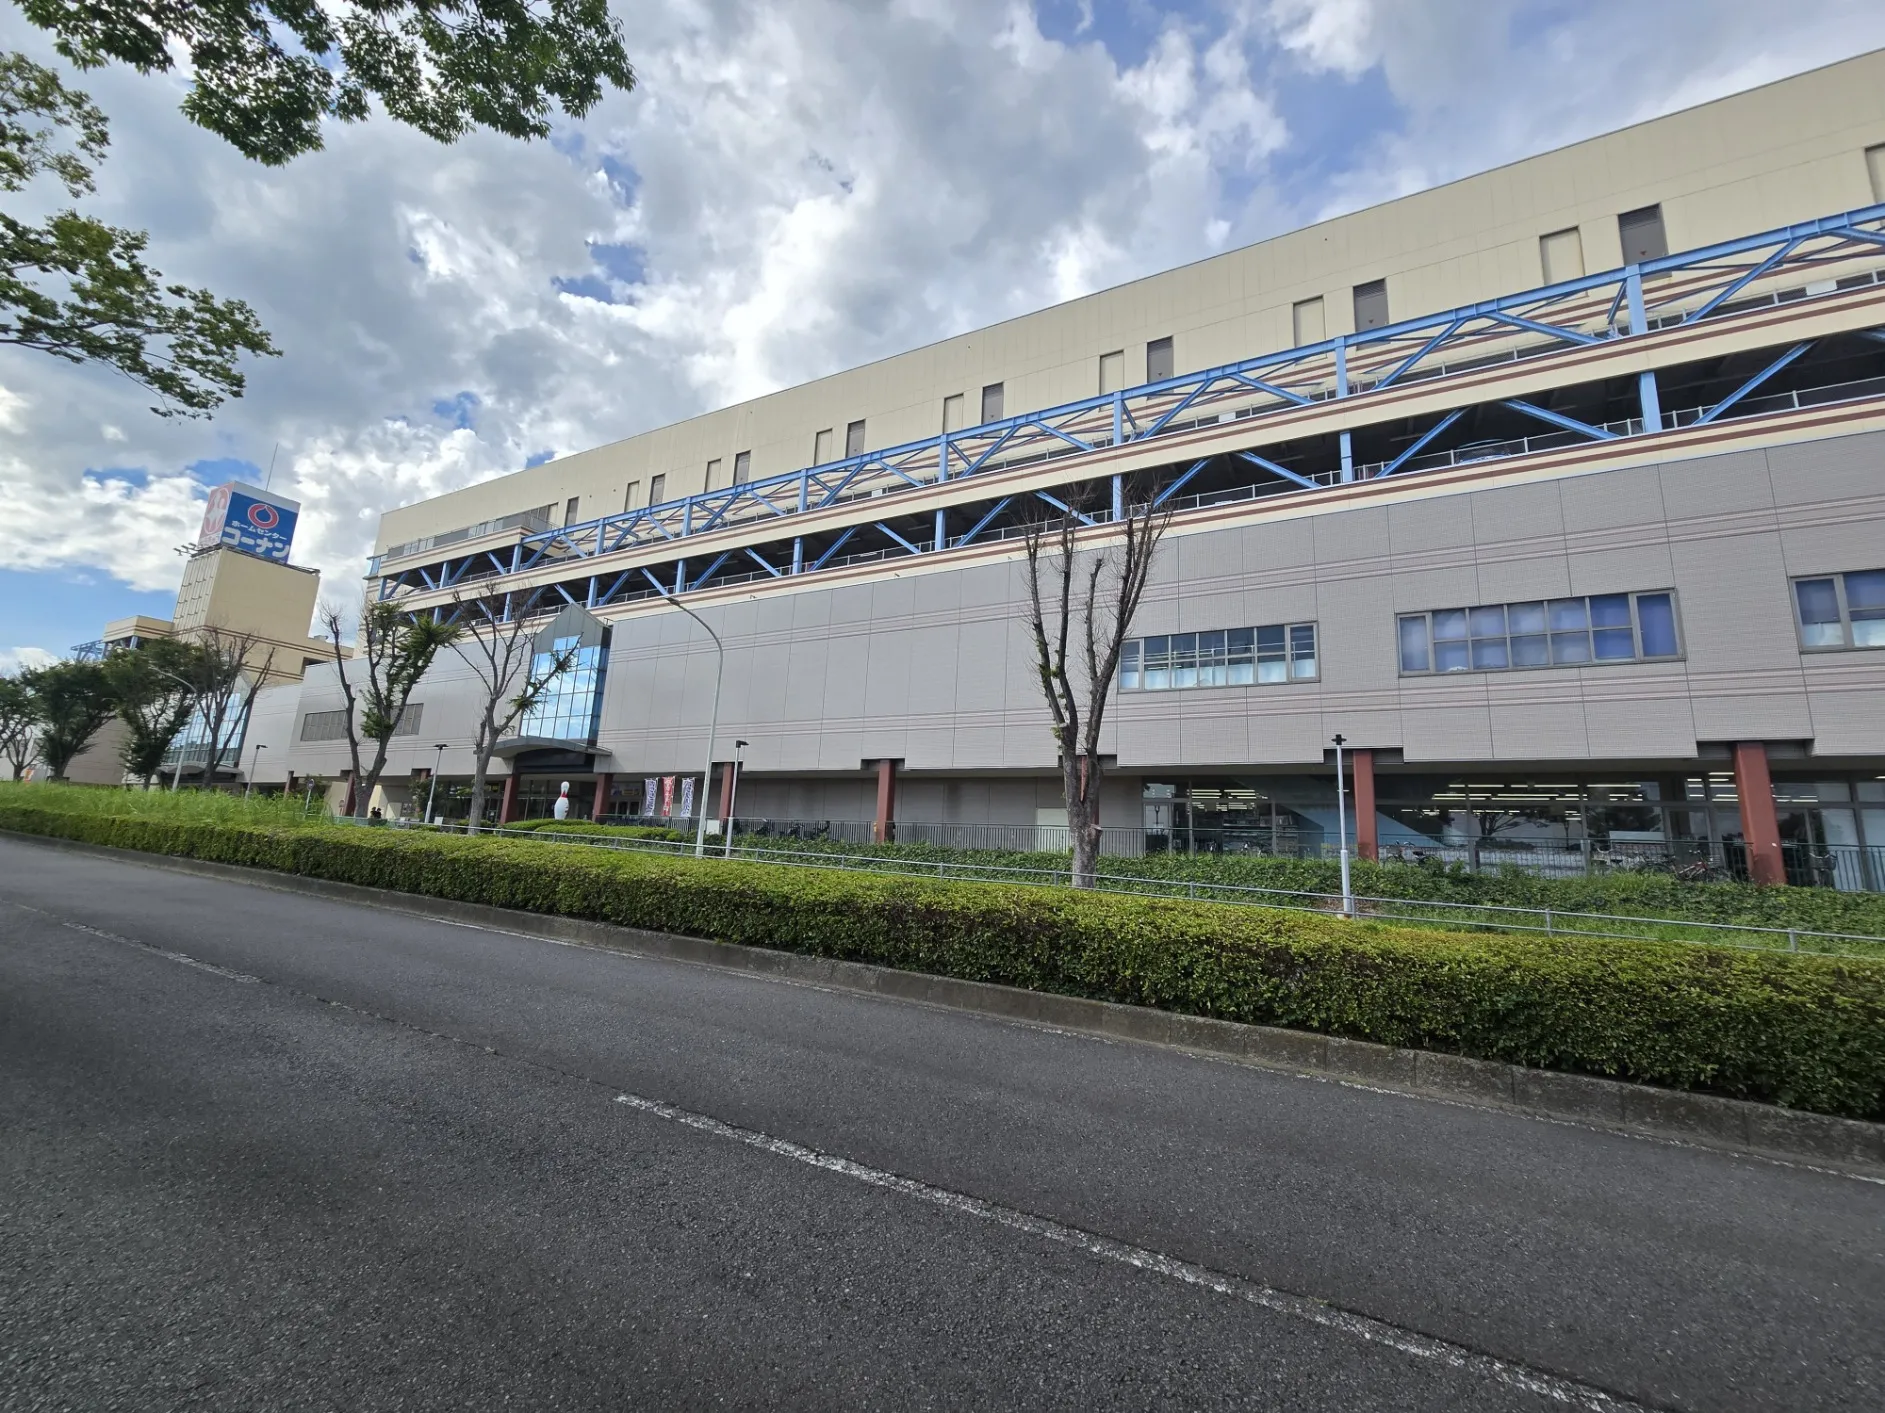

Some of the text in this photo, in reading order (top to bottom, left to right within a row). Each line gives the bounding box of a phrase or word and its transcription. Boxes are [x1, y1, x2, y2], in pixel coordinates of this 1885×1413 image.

[222, 526, 290, 558] コーナン
[231, 520, 287, 540] ホームセンター
